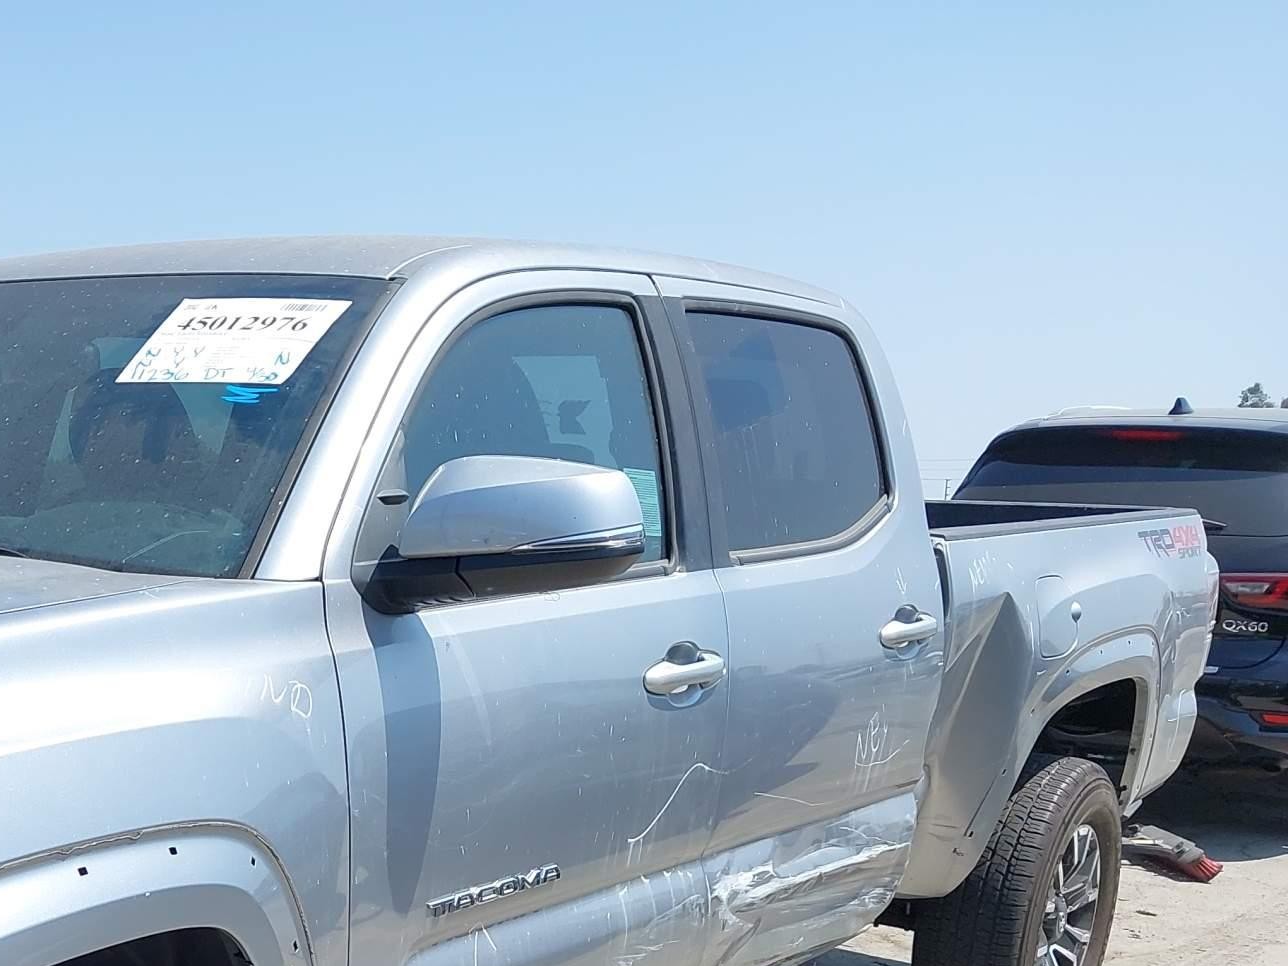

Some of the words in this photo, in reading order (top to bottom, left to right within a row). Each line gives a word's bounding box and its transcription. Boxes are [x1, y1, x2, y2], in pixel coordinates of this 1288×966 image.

[176, 315, 312, 332] 45012976
[1137, 528, 1177, 558] TRD
[1222, 619, 1269, 633] QX60
[425, 862, 561, 918] TACOMA
